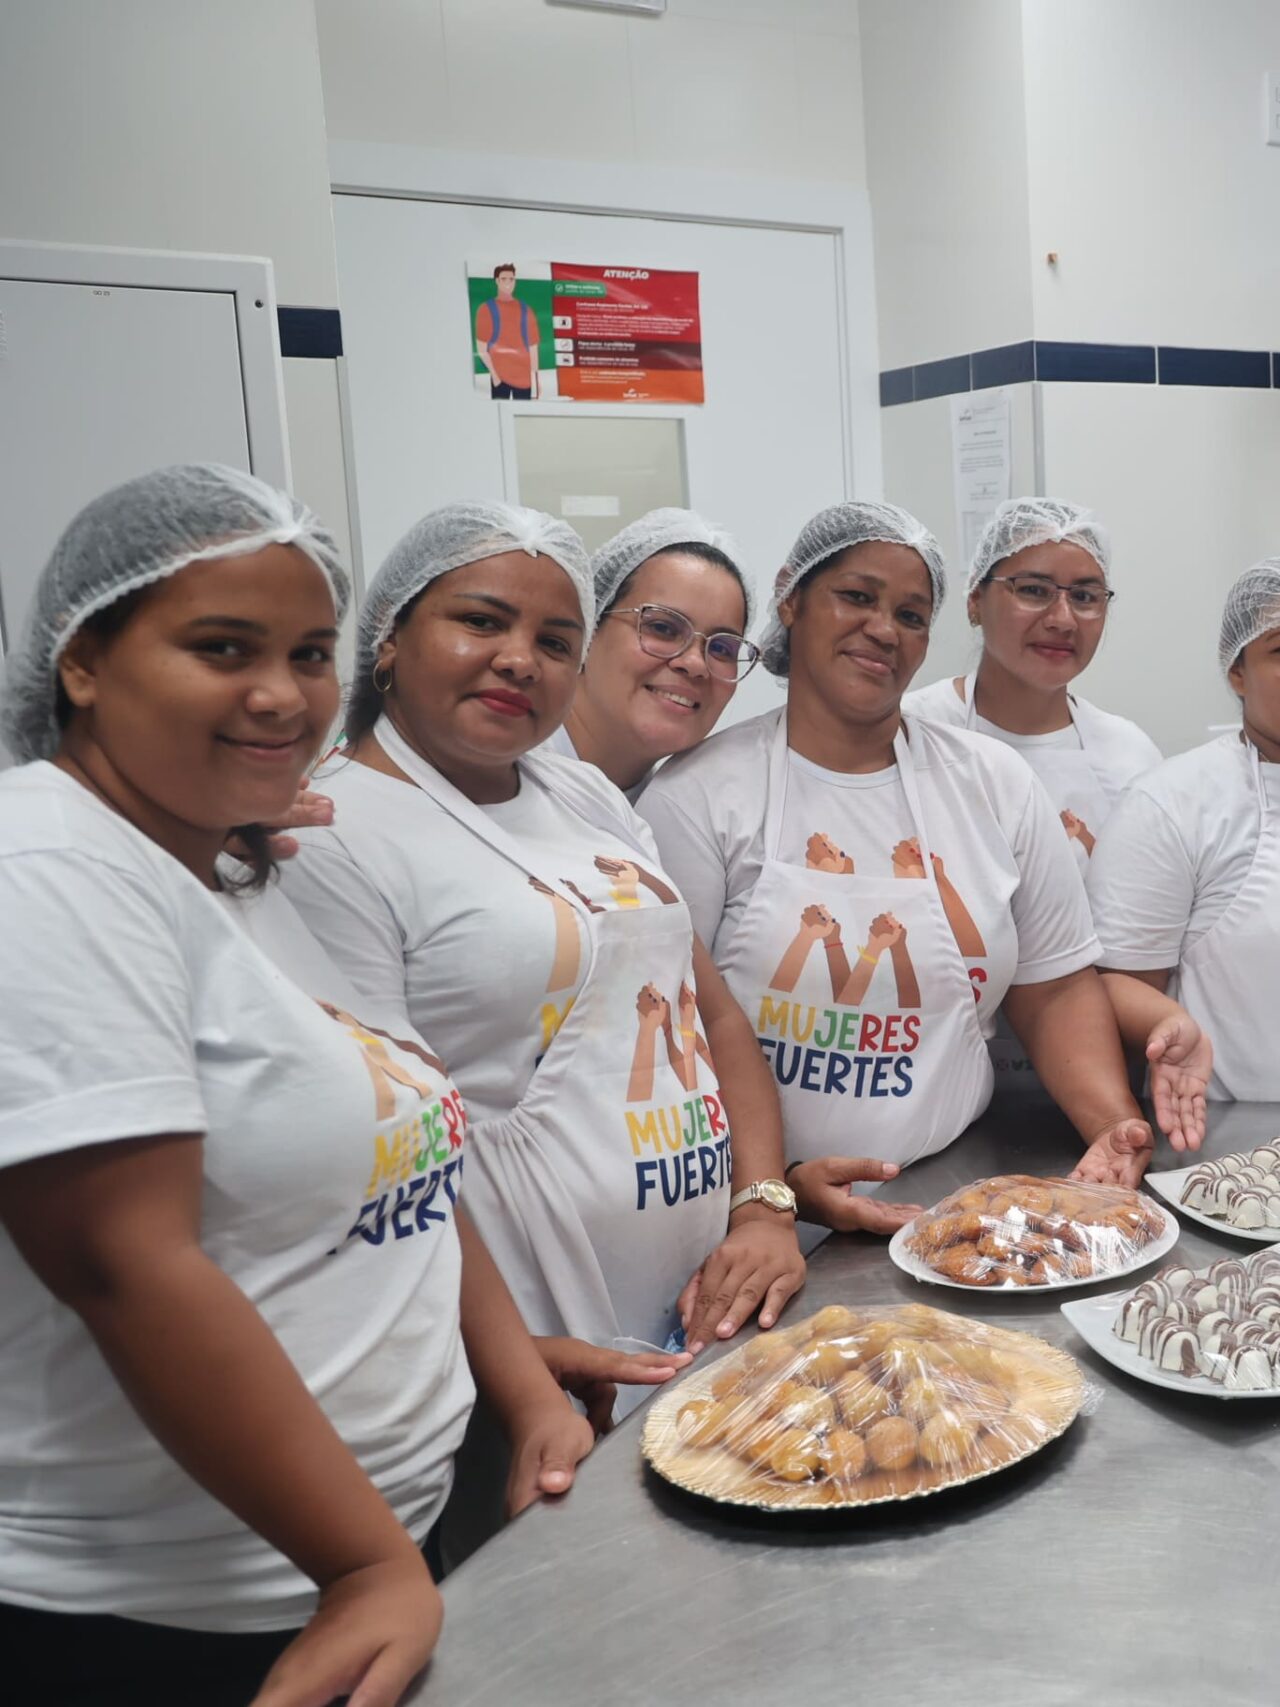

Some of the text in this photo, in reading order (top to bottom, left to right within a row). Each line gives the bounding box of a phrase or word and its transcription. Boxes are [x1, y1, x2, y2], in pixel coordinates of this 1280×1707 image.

[603, 269, 650, 280] ATENÇÃO
[757, 995, 921, 1053] MUJERES
[624, 1089, 726, 1157] MUJER
